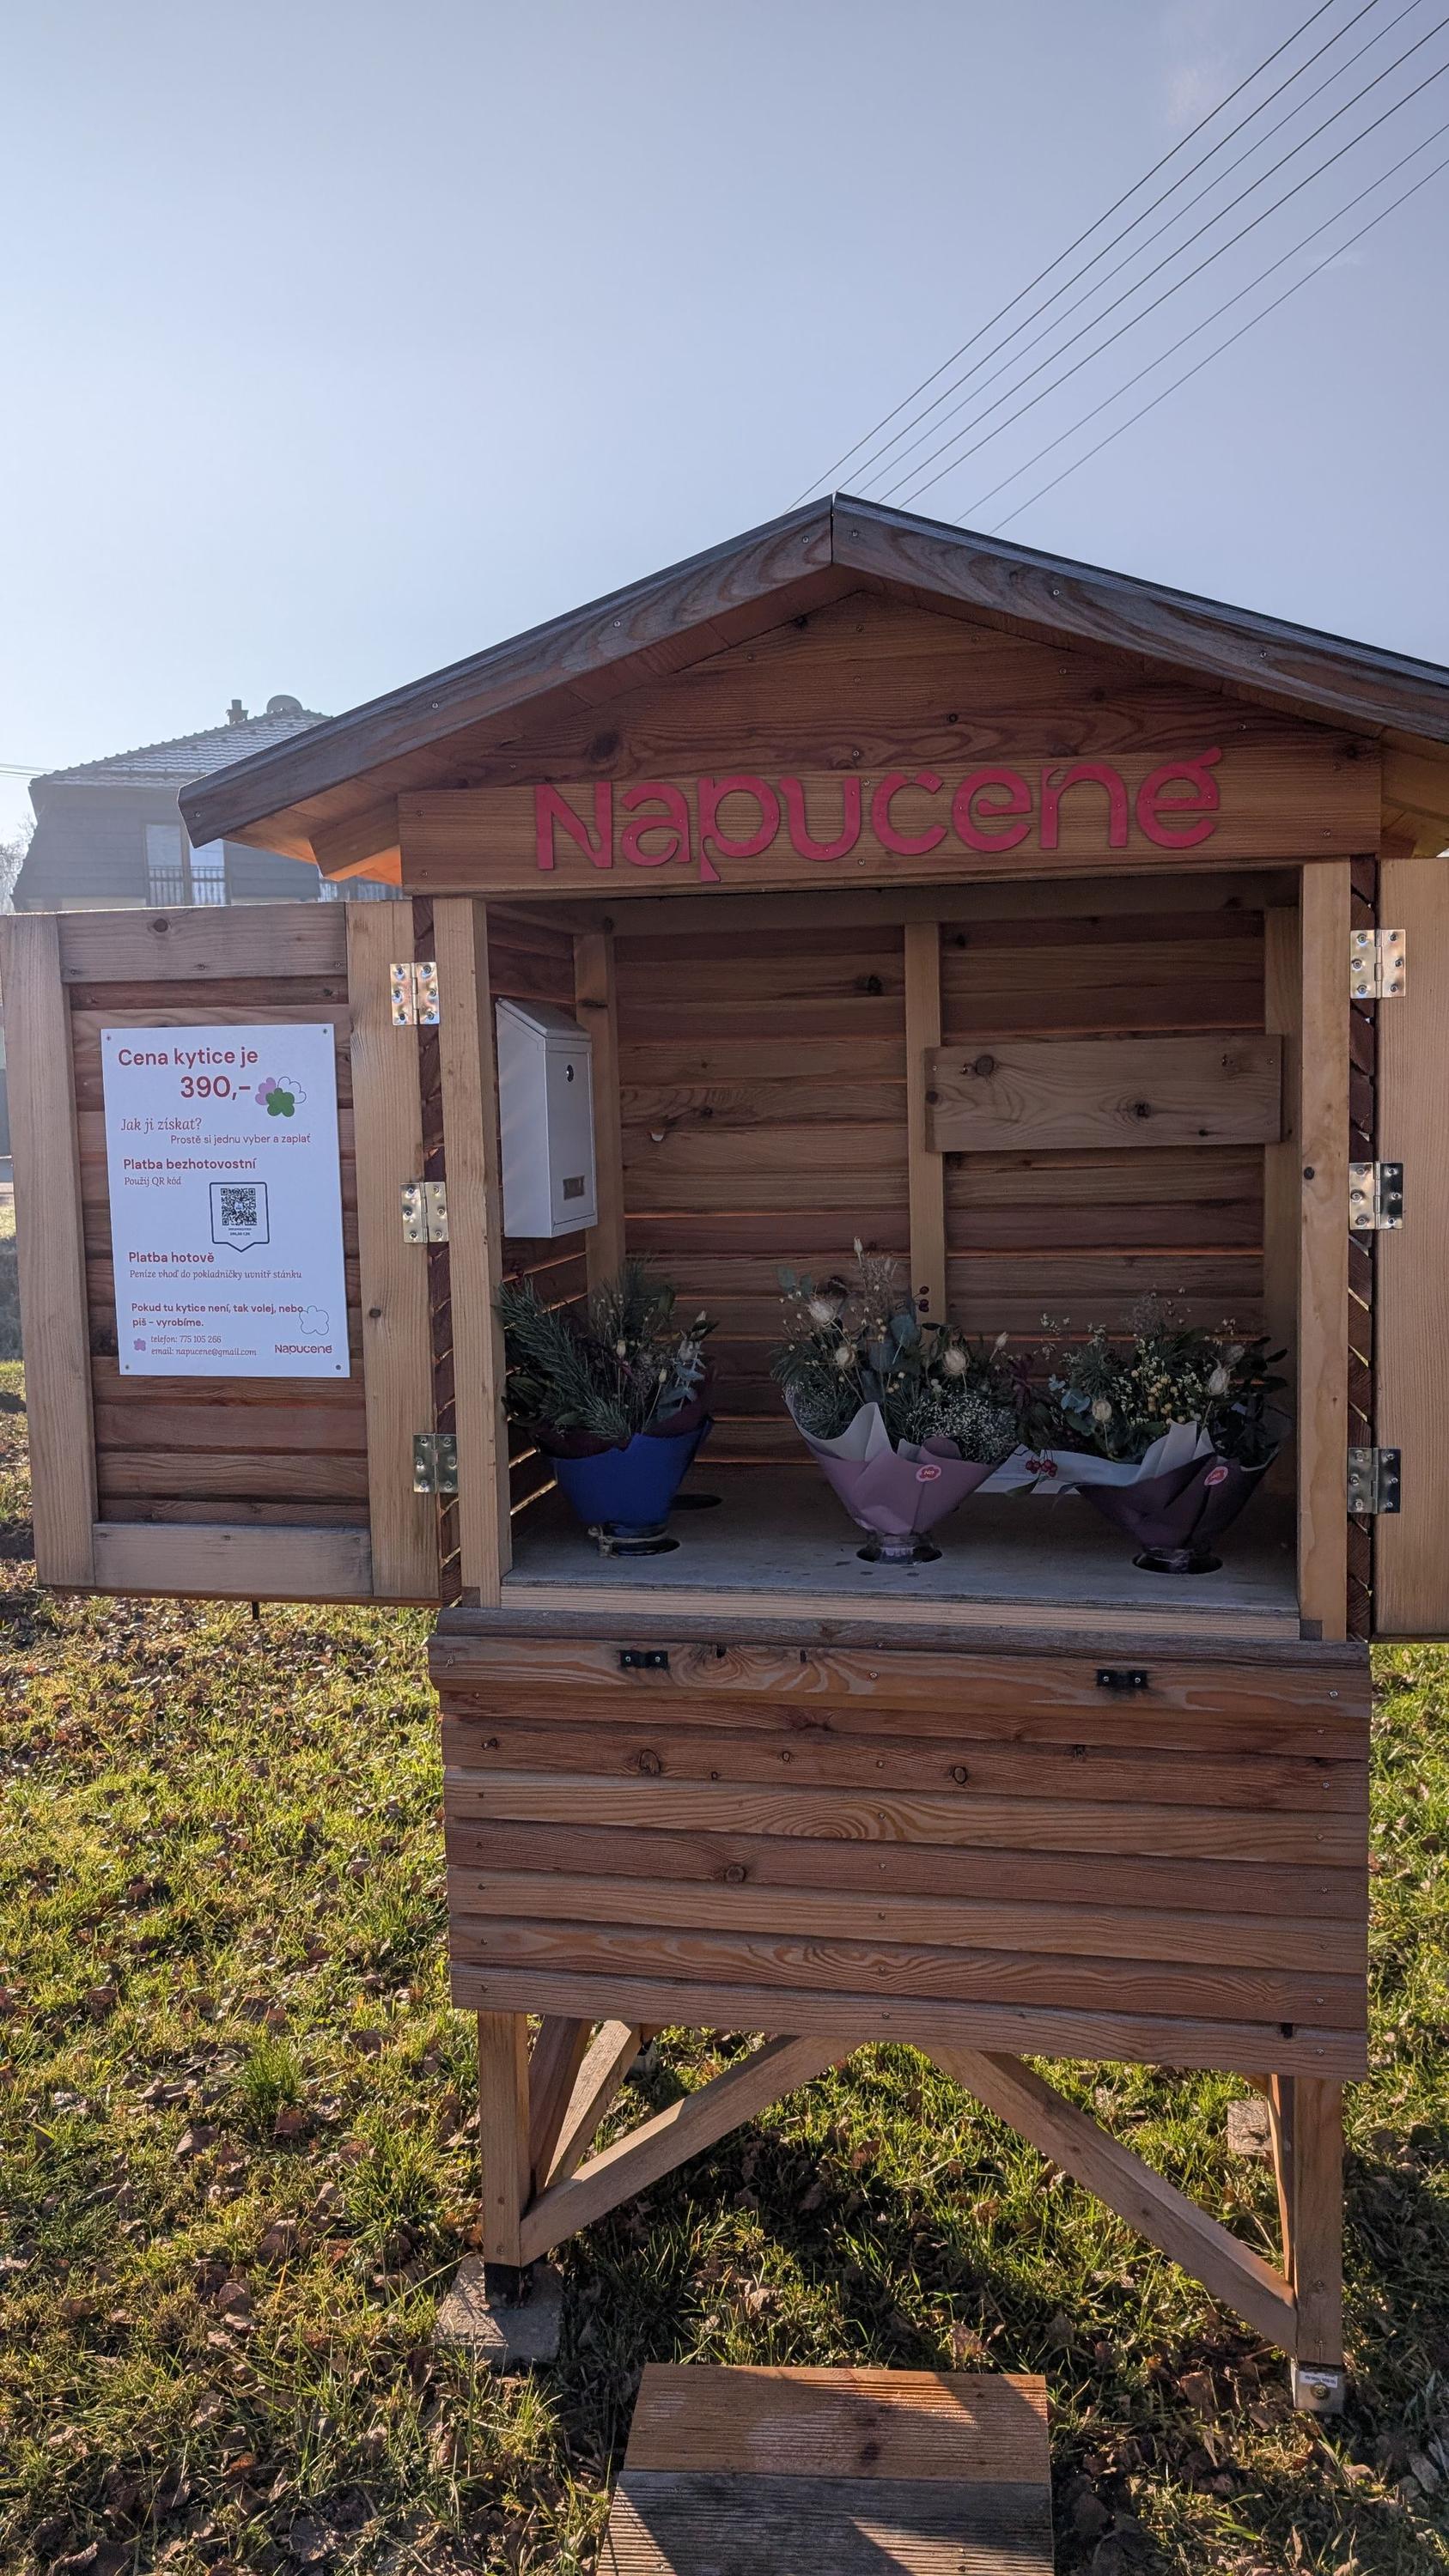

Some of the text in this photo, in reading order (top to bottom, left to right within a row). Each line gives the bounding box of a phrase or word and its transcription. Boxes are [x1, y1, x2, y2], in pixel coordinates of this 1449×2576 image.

[535, 747, 1223, 882] Napucené
[119, 1047, 258, 1069] Cena kytice je
[120, 1117, 202, 1134] Jak ji získat?
[171, 1134, 201, 1145] Prostě
[204, 1134, 211, 1144] si
[214, 1134, 240, 1145] jednu
[243, 1134, 271, 1145] vyber
[282, 1133, 311, 1145] zaplať
[124, 1157, 257, 1170] Platba bezhotovostní
[125, 1176, 182, 1187] Použij QR kód
[129, 1251, 215, 1263] Platba hotově
[158, 1269, 179, 1278] vhoď
[193, 1269, 242, 1280] pokladničky
[245, 1269, 271, 1279] uvnitř
[273, 1269, 302, 1279] stánku
[131, 1303, 161, 1312] Pokud
[175, 1303, 205, 1314] kytice
[208, 1303, 231, 1313] není,
[234, 1303, 249, 1312] tak
[251, 1303, 276, 1314] volej,
[279, 1303, 303, 1313] nebo
[132, 1318, 147, 1327] piš
[156, 1317, 204, 1328] vyrobíme.
[150, 1335, 177, 1345] telefon:
[208, 1335, 222, 1344] 266
[176, 1347, 257, 1357] napucene@gmail.com
